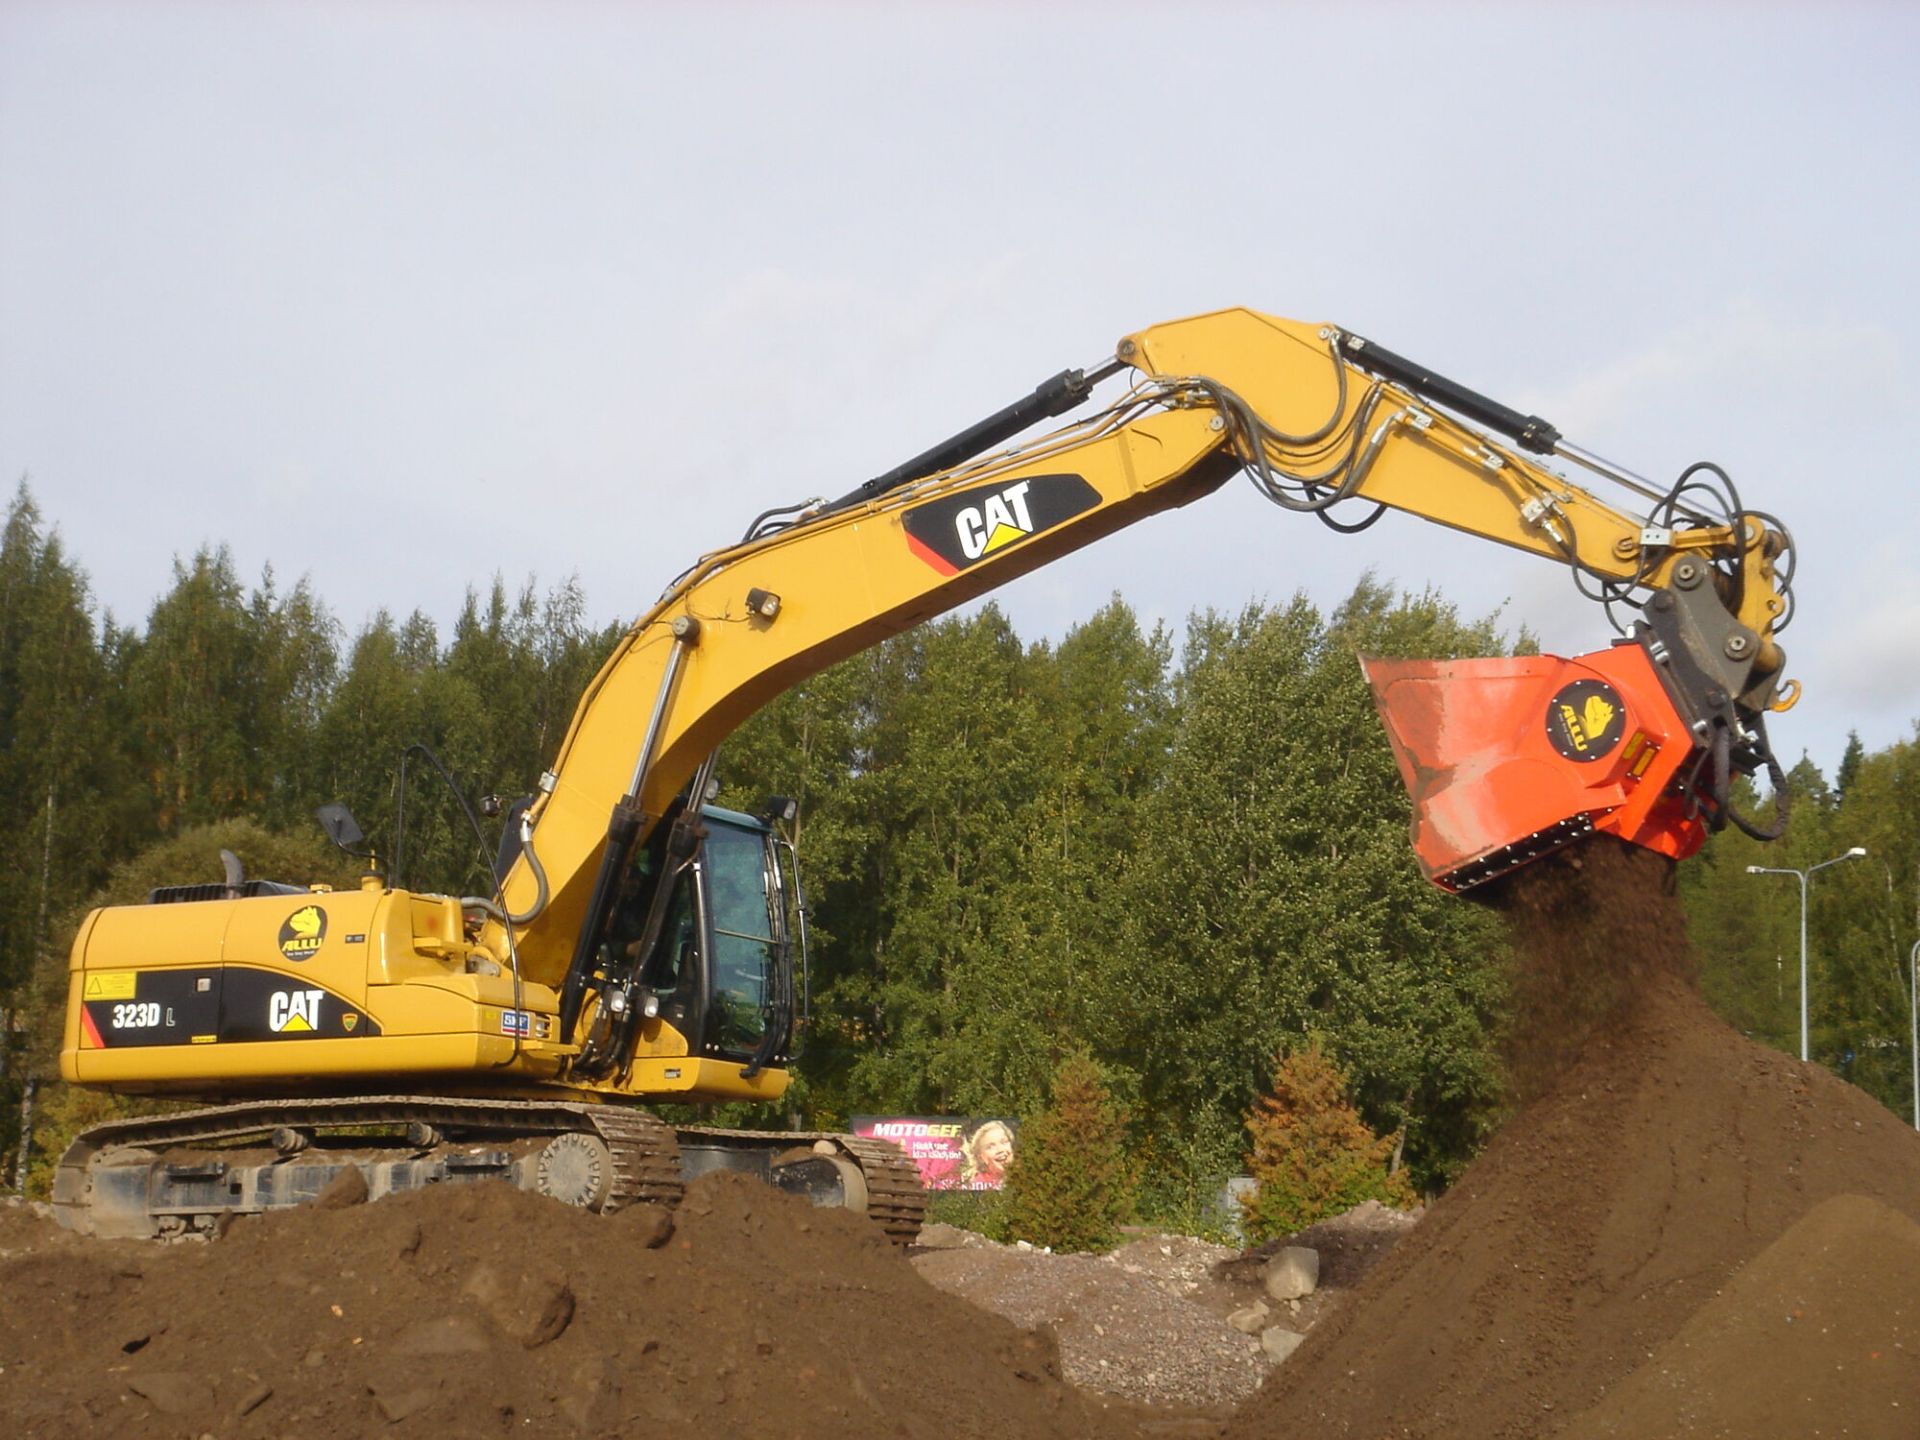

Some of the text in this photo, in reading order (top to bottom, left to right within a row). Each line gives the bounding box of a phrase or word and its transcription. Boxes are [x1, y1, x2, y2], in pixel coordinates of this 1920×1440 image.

[955, 481, 1034, 560] CAT
[1560, 705, 1588, 751] ALLU
[281, 937, 322, 952] ALLU
[112, 1002, 176, 1028] 323D L
[269, 990, 324, 1032] CAT
